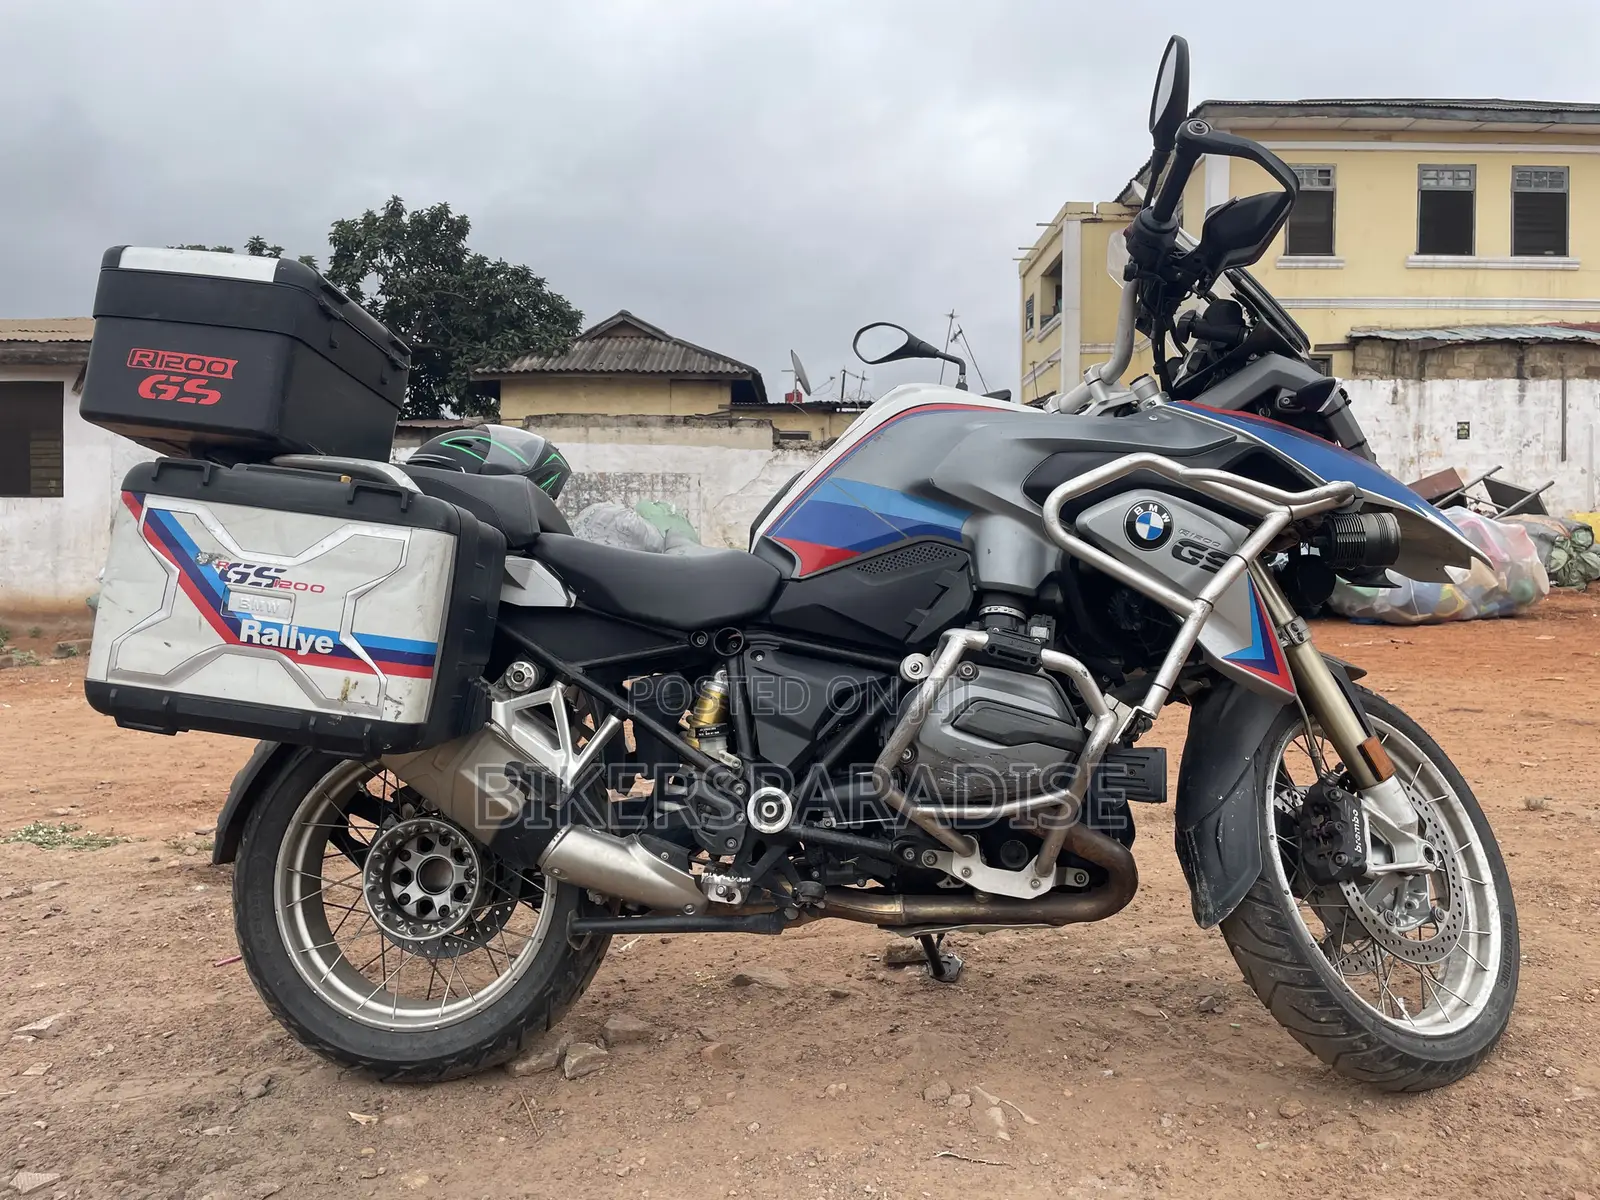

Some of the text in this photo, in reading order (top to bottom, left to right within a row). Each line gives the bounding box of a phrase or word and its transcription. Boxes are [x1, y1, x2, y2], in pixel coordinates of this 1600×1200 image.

[128, 349, 232, 377] R1200
[138, 374, 222, 405] GS
[1133, 504, 1171, 523] BMW
[219, 562, 288, 588] GS
[273, 579, 325, 593] 1200
[239, 596, 281, 614] BMW
[240, 618, 334, 656] Rallye
[1352, 809, 1362, 853] brembo
